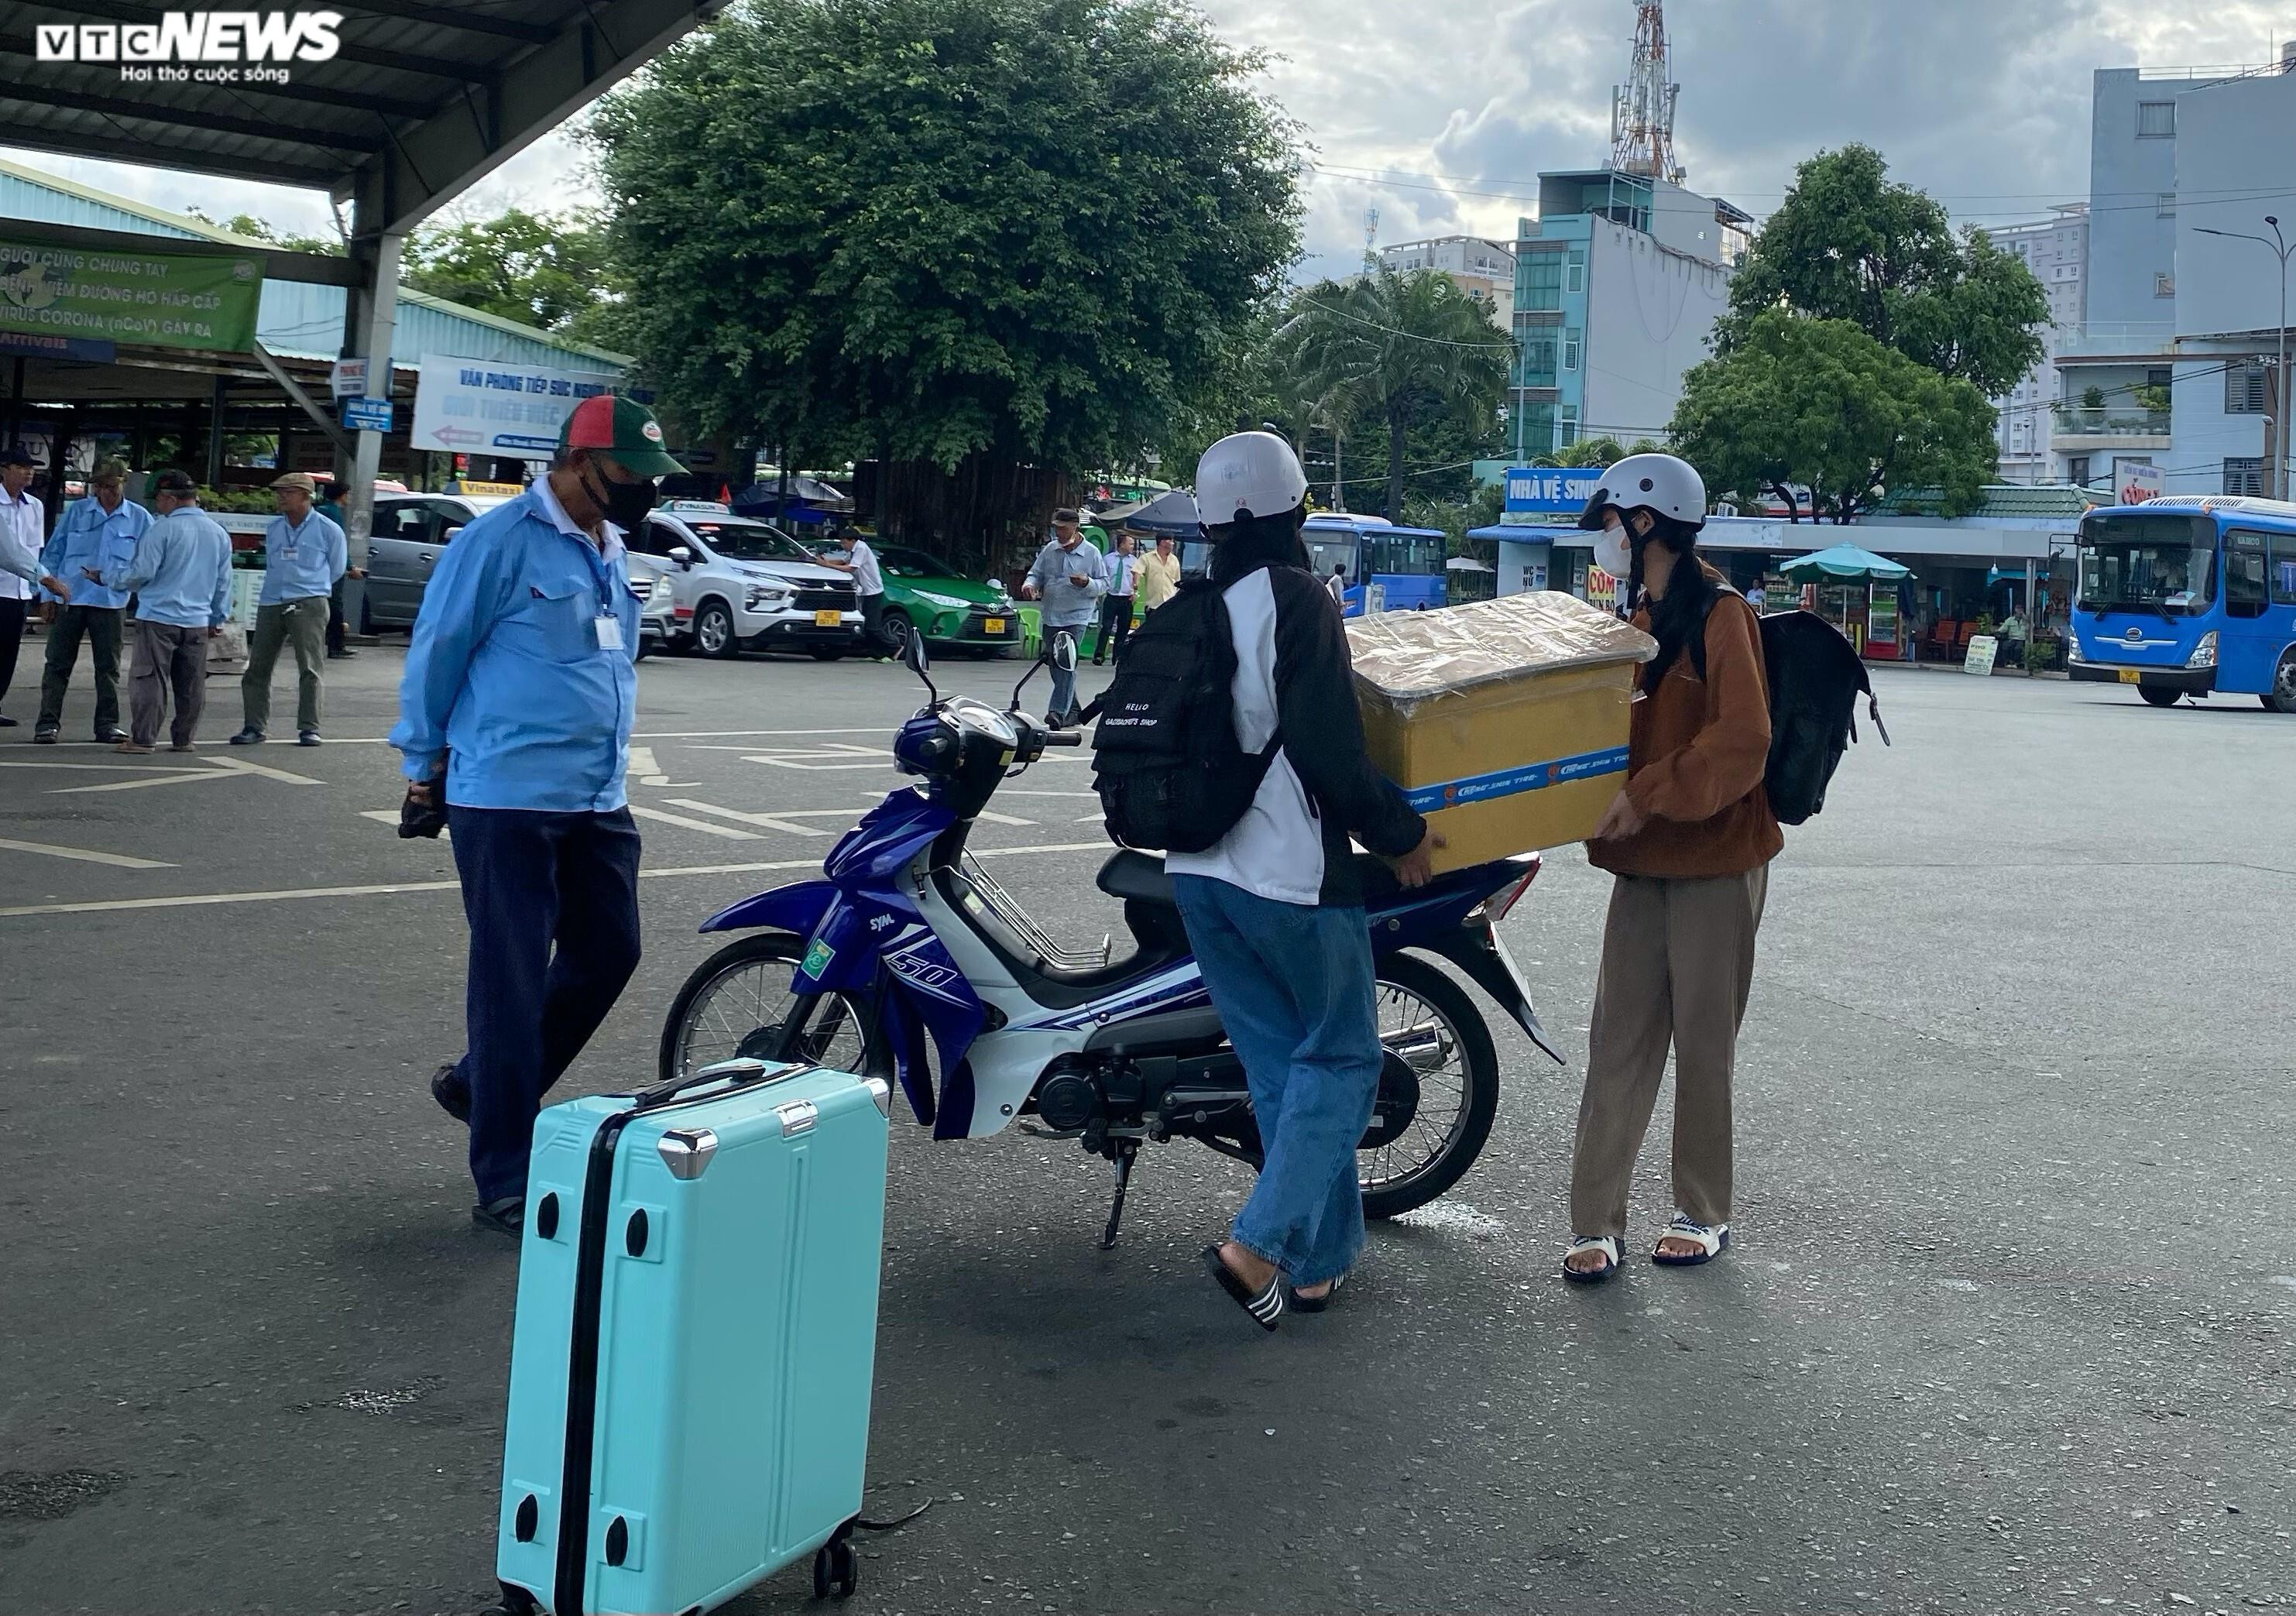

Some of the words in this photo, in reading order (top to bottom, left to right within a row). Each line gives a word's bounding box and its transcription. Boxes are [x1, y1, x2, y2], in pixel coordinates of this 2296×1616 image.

[41, 249, 84, 269] CÙNG
[89, 258, 141, 276] CHUNG
[146, 262, 168, 279] TAY
[39, 310, 104, 328] CORONA
[194, 323, 212, 338] RA
[466, 482, 521, 495] Vinataxi
[1510, 474, 1541, 499] NHÀ
[1543, 475, 1562, 503] VỆ
[1523, 565, 1533, 575] WC
[870, 913, 895, 932] SYM
[887, 951, 959, 988] 50
